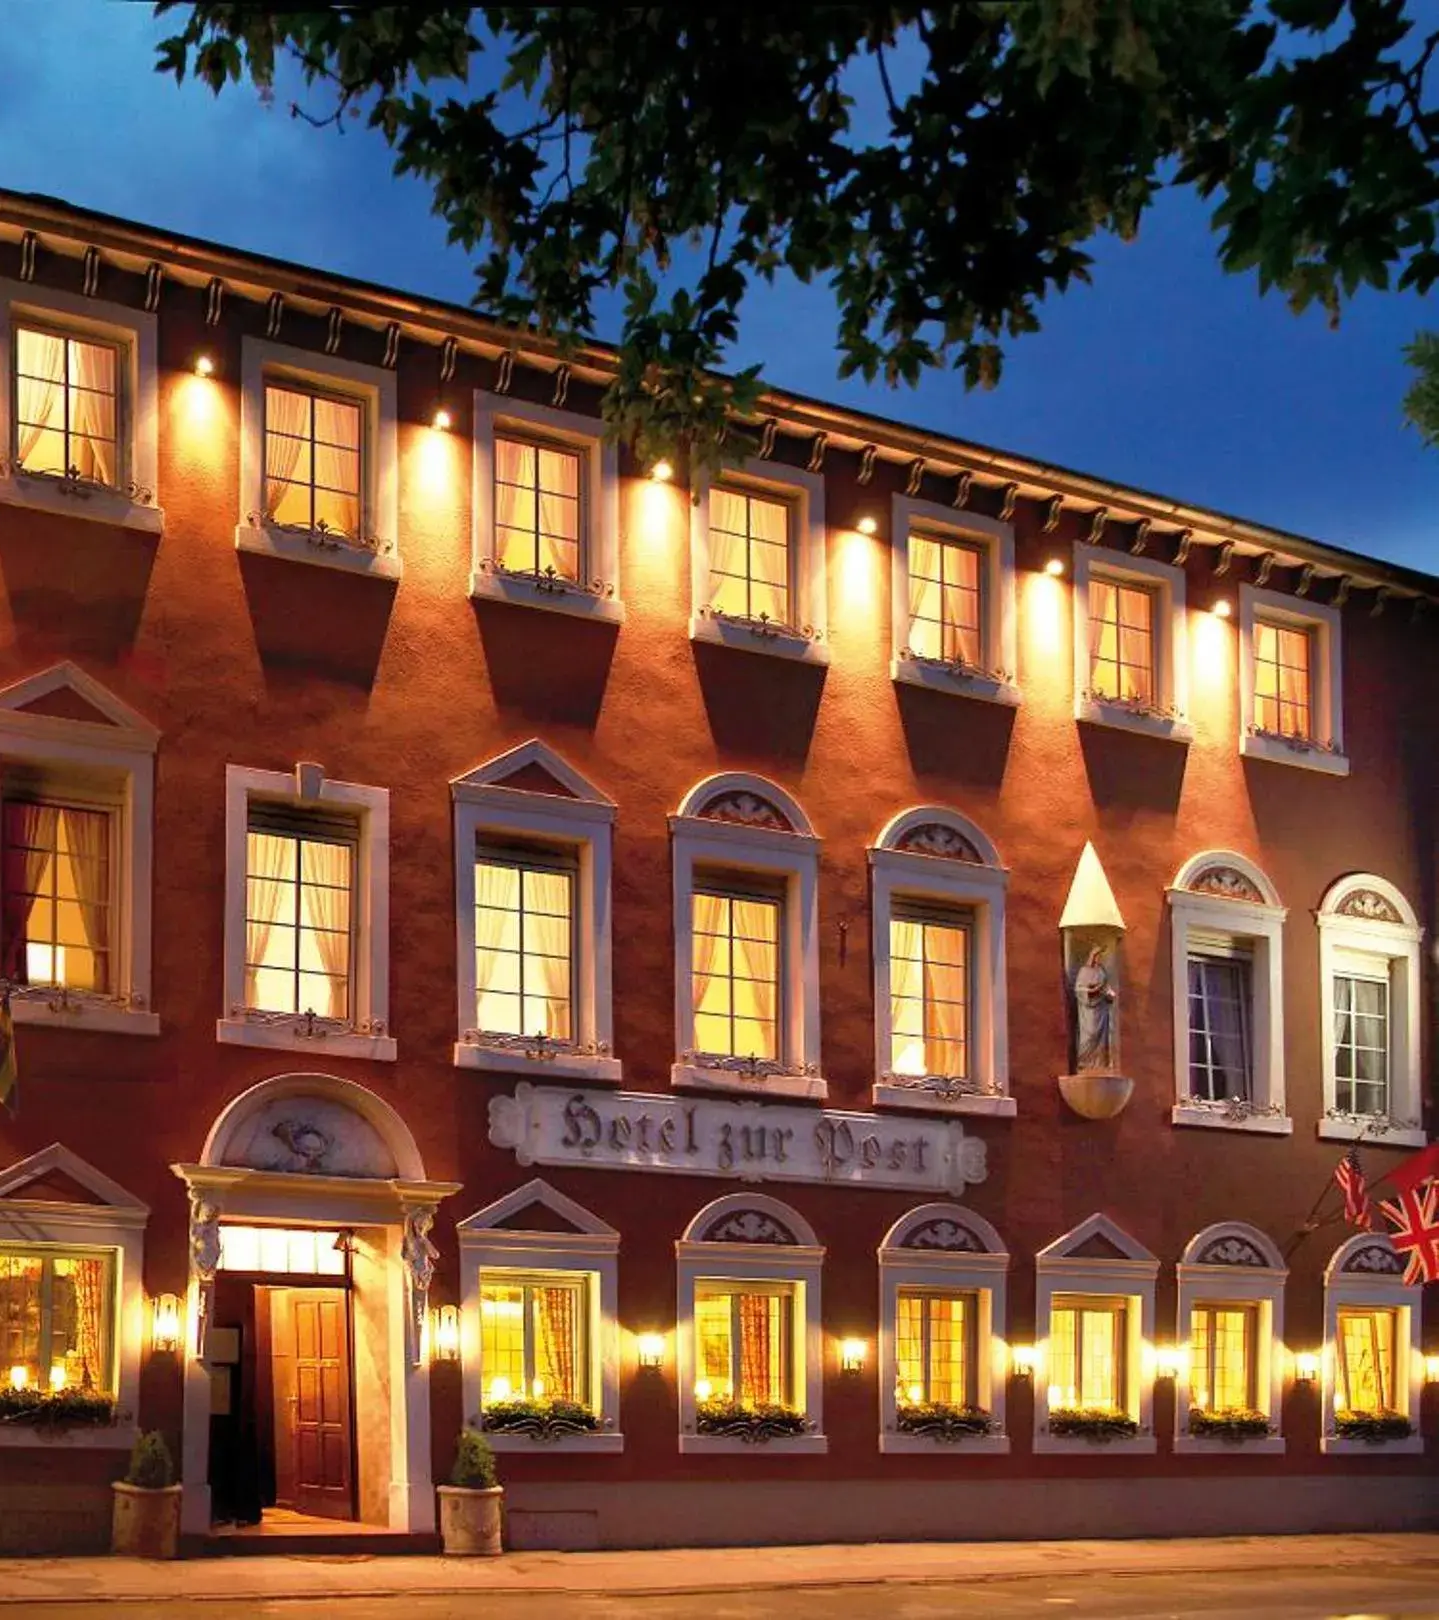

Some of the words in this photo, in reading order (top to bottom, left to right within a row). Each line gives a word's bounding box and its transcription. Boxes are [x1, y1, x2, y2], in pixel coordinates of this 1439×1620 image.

[561, 1093, 698, 1158] Hotel
[718, 1122, 794, 1170] zur
[813, 1118, 930, 1182] Post
